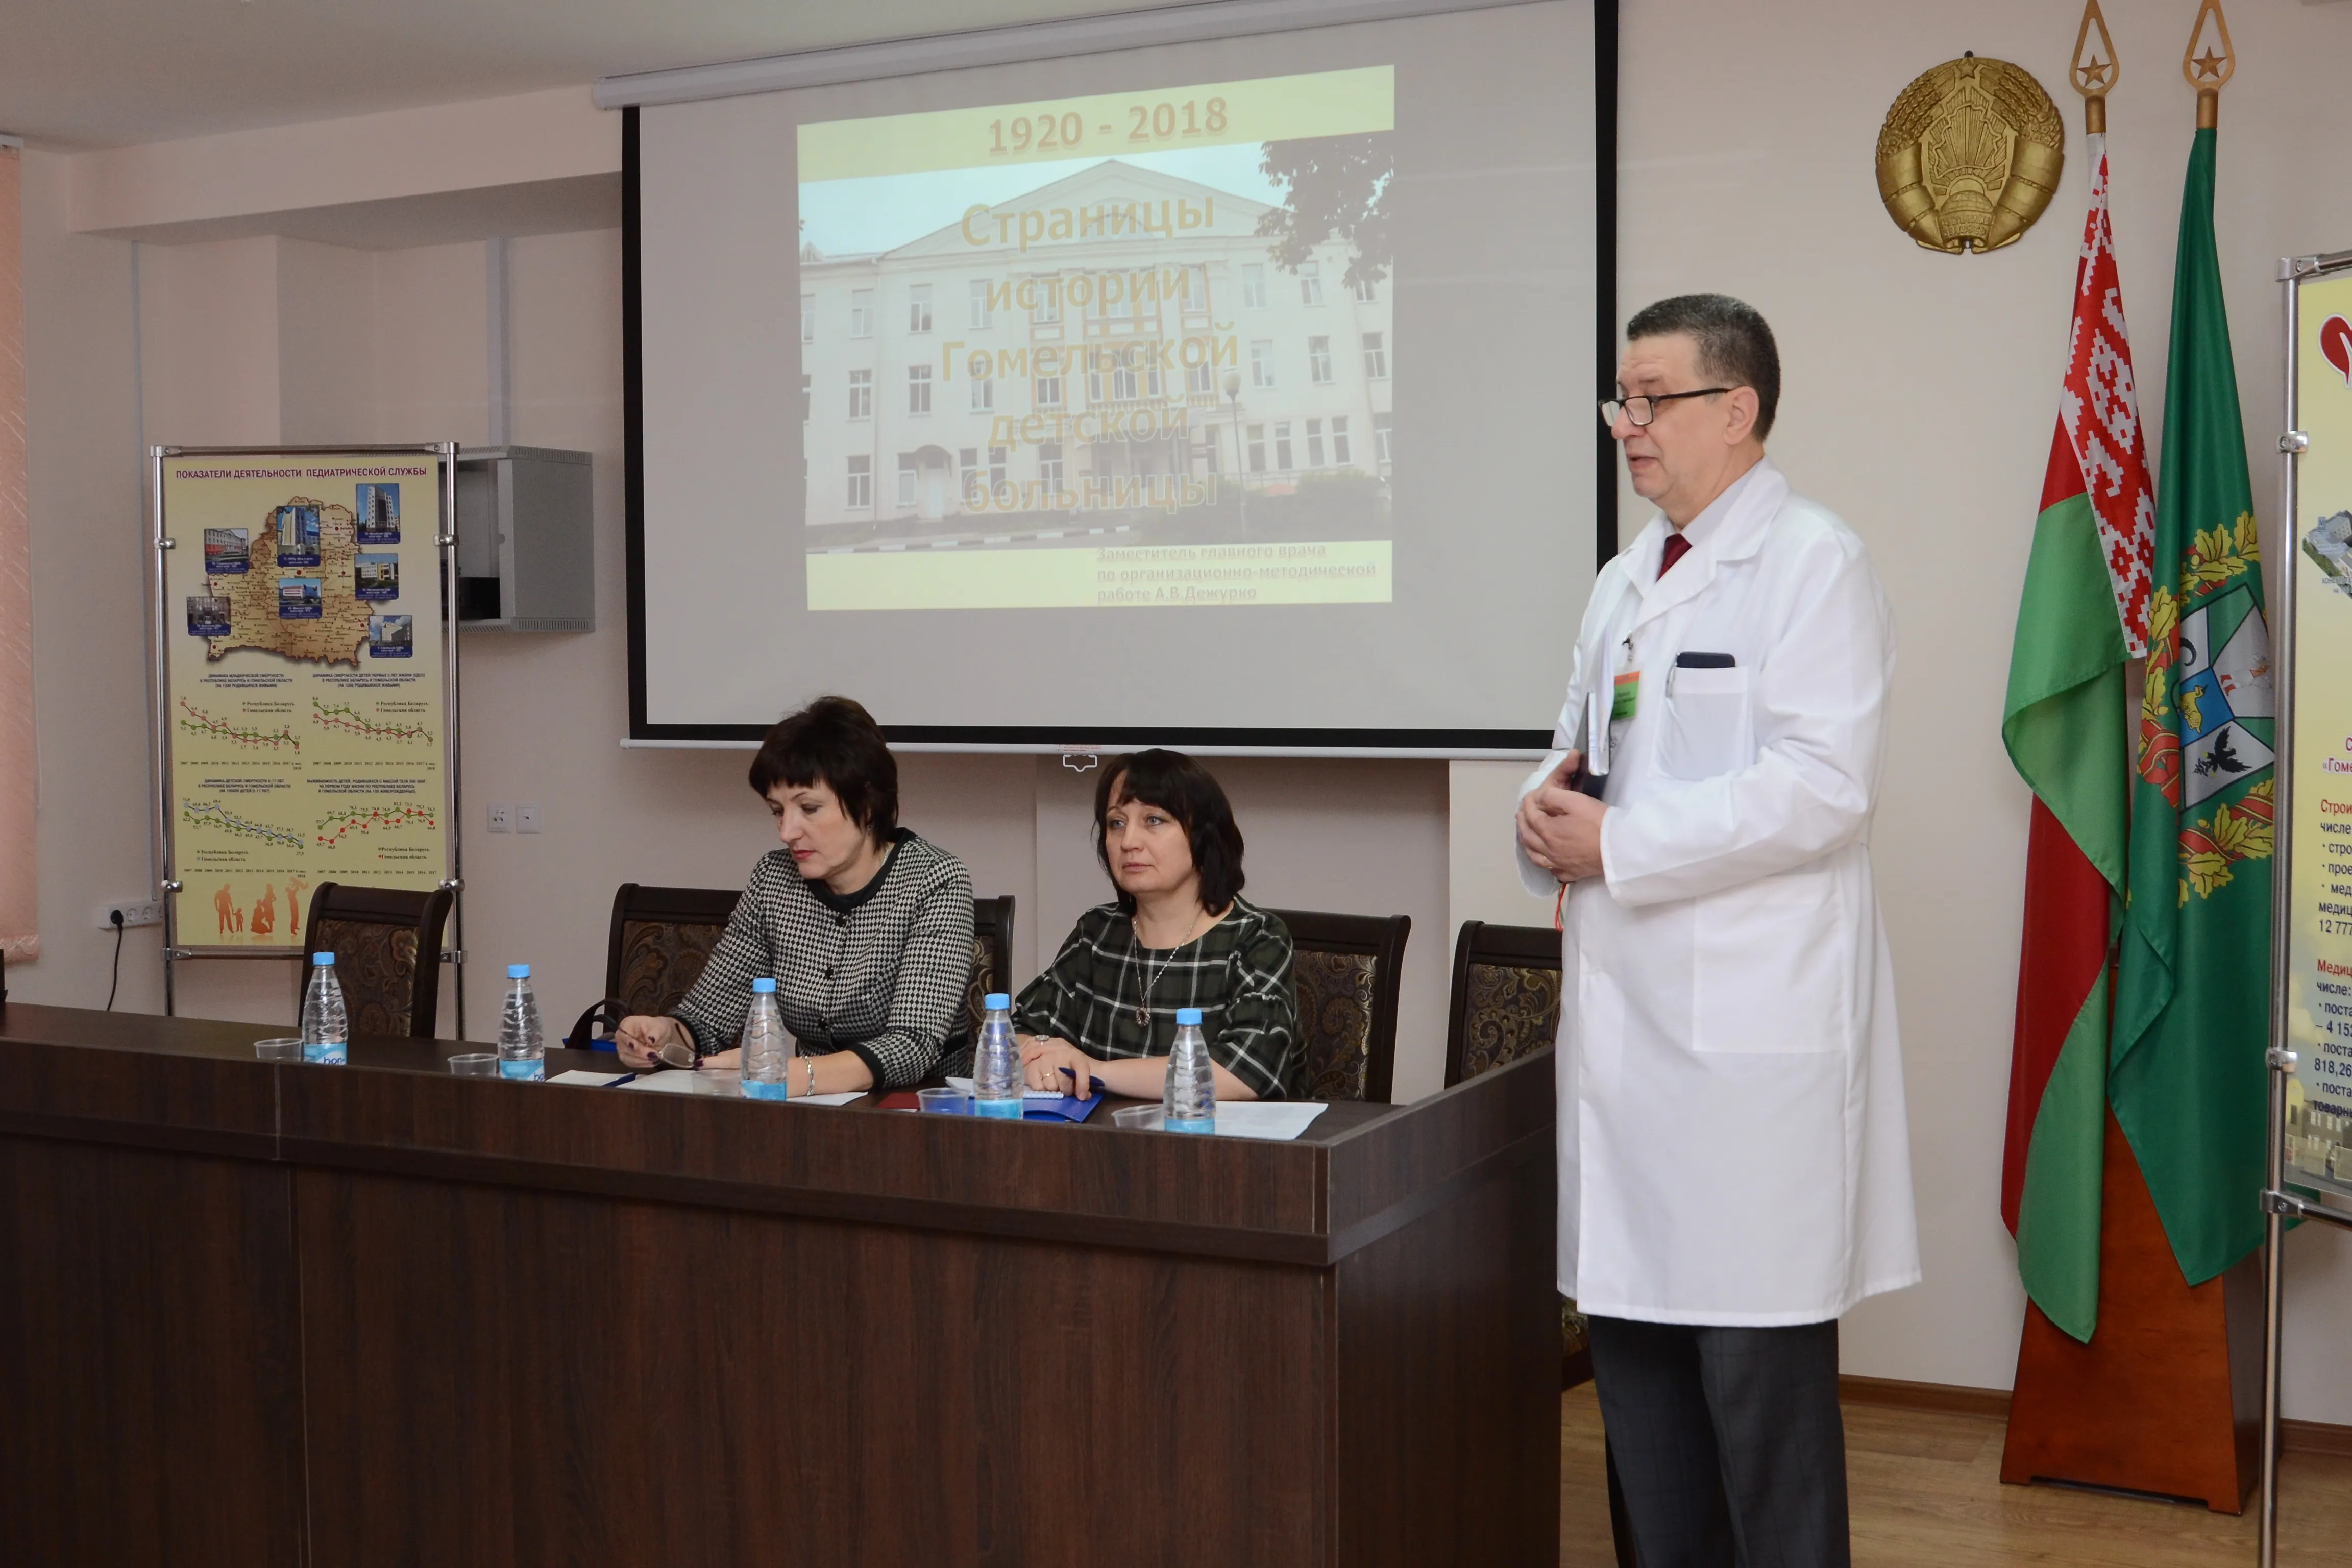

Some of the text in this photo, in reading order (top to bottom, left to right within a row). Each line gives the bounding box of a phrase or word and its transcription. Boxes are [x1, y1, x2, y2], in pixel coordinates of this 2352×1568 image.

[989, 112, 1083, 153] 1920
[1128, 97, 1228, 141] 2018
[961, 197, 1214, 253] Страницы
[986, 266, 1190, 317] истории
[941, 321, 1238, 382] Гомельской
[988, 393, 1189, 453] детской
[176, 466, 426, 478] ПОКАЗАТЕЛИ ДЕЯТЕЛЬНОСТИ ПЕДИАТРИЧЕСКОЙ СЛУЖБЫ
[963, 470, 1217, 514] больницы
[1097, 544, 1326, 560] Заместитель главного врача
[1098, 562, 1377, 582] по организационно-методической
[1098, 587, 1150, 602] работе
[2319, 919, 2332, 933] 12
[2316, 981, 2352, 996] числе:
[2326, 1020, 2333, 1033] 4
